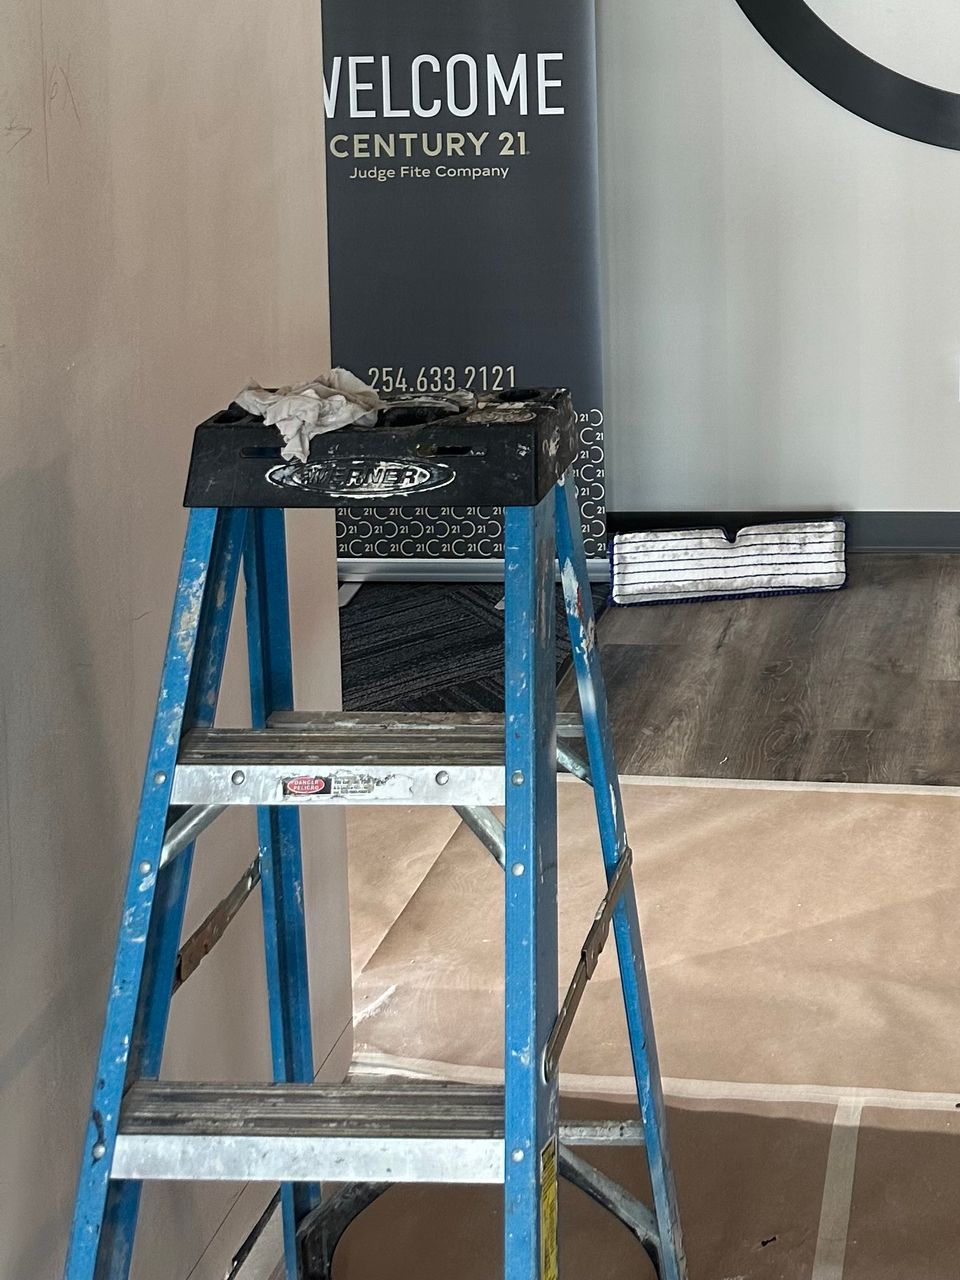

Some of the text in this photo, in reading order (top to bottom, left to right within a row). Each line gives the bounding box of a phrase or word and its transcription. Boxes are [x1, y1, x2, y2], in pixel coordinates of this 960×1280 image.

[329, 131, 526, 158] CENTURY 21
[349, 165, 510, 182] Judge Fite Company
[368, 366, 515, 393] 254.633.2121
[301, 466, 417, 486] WERNER
